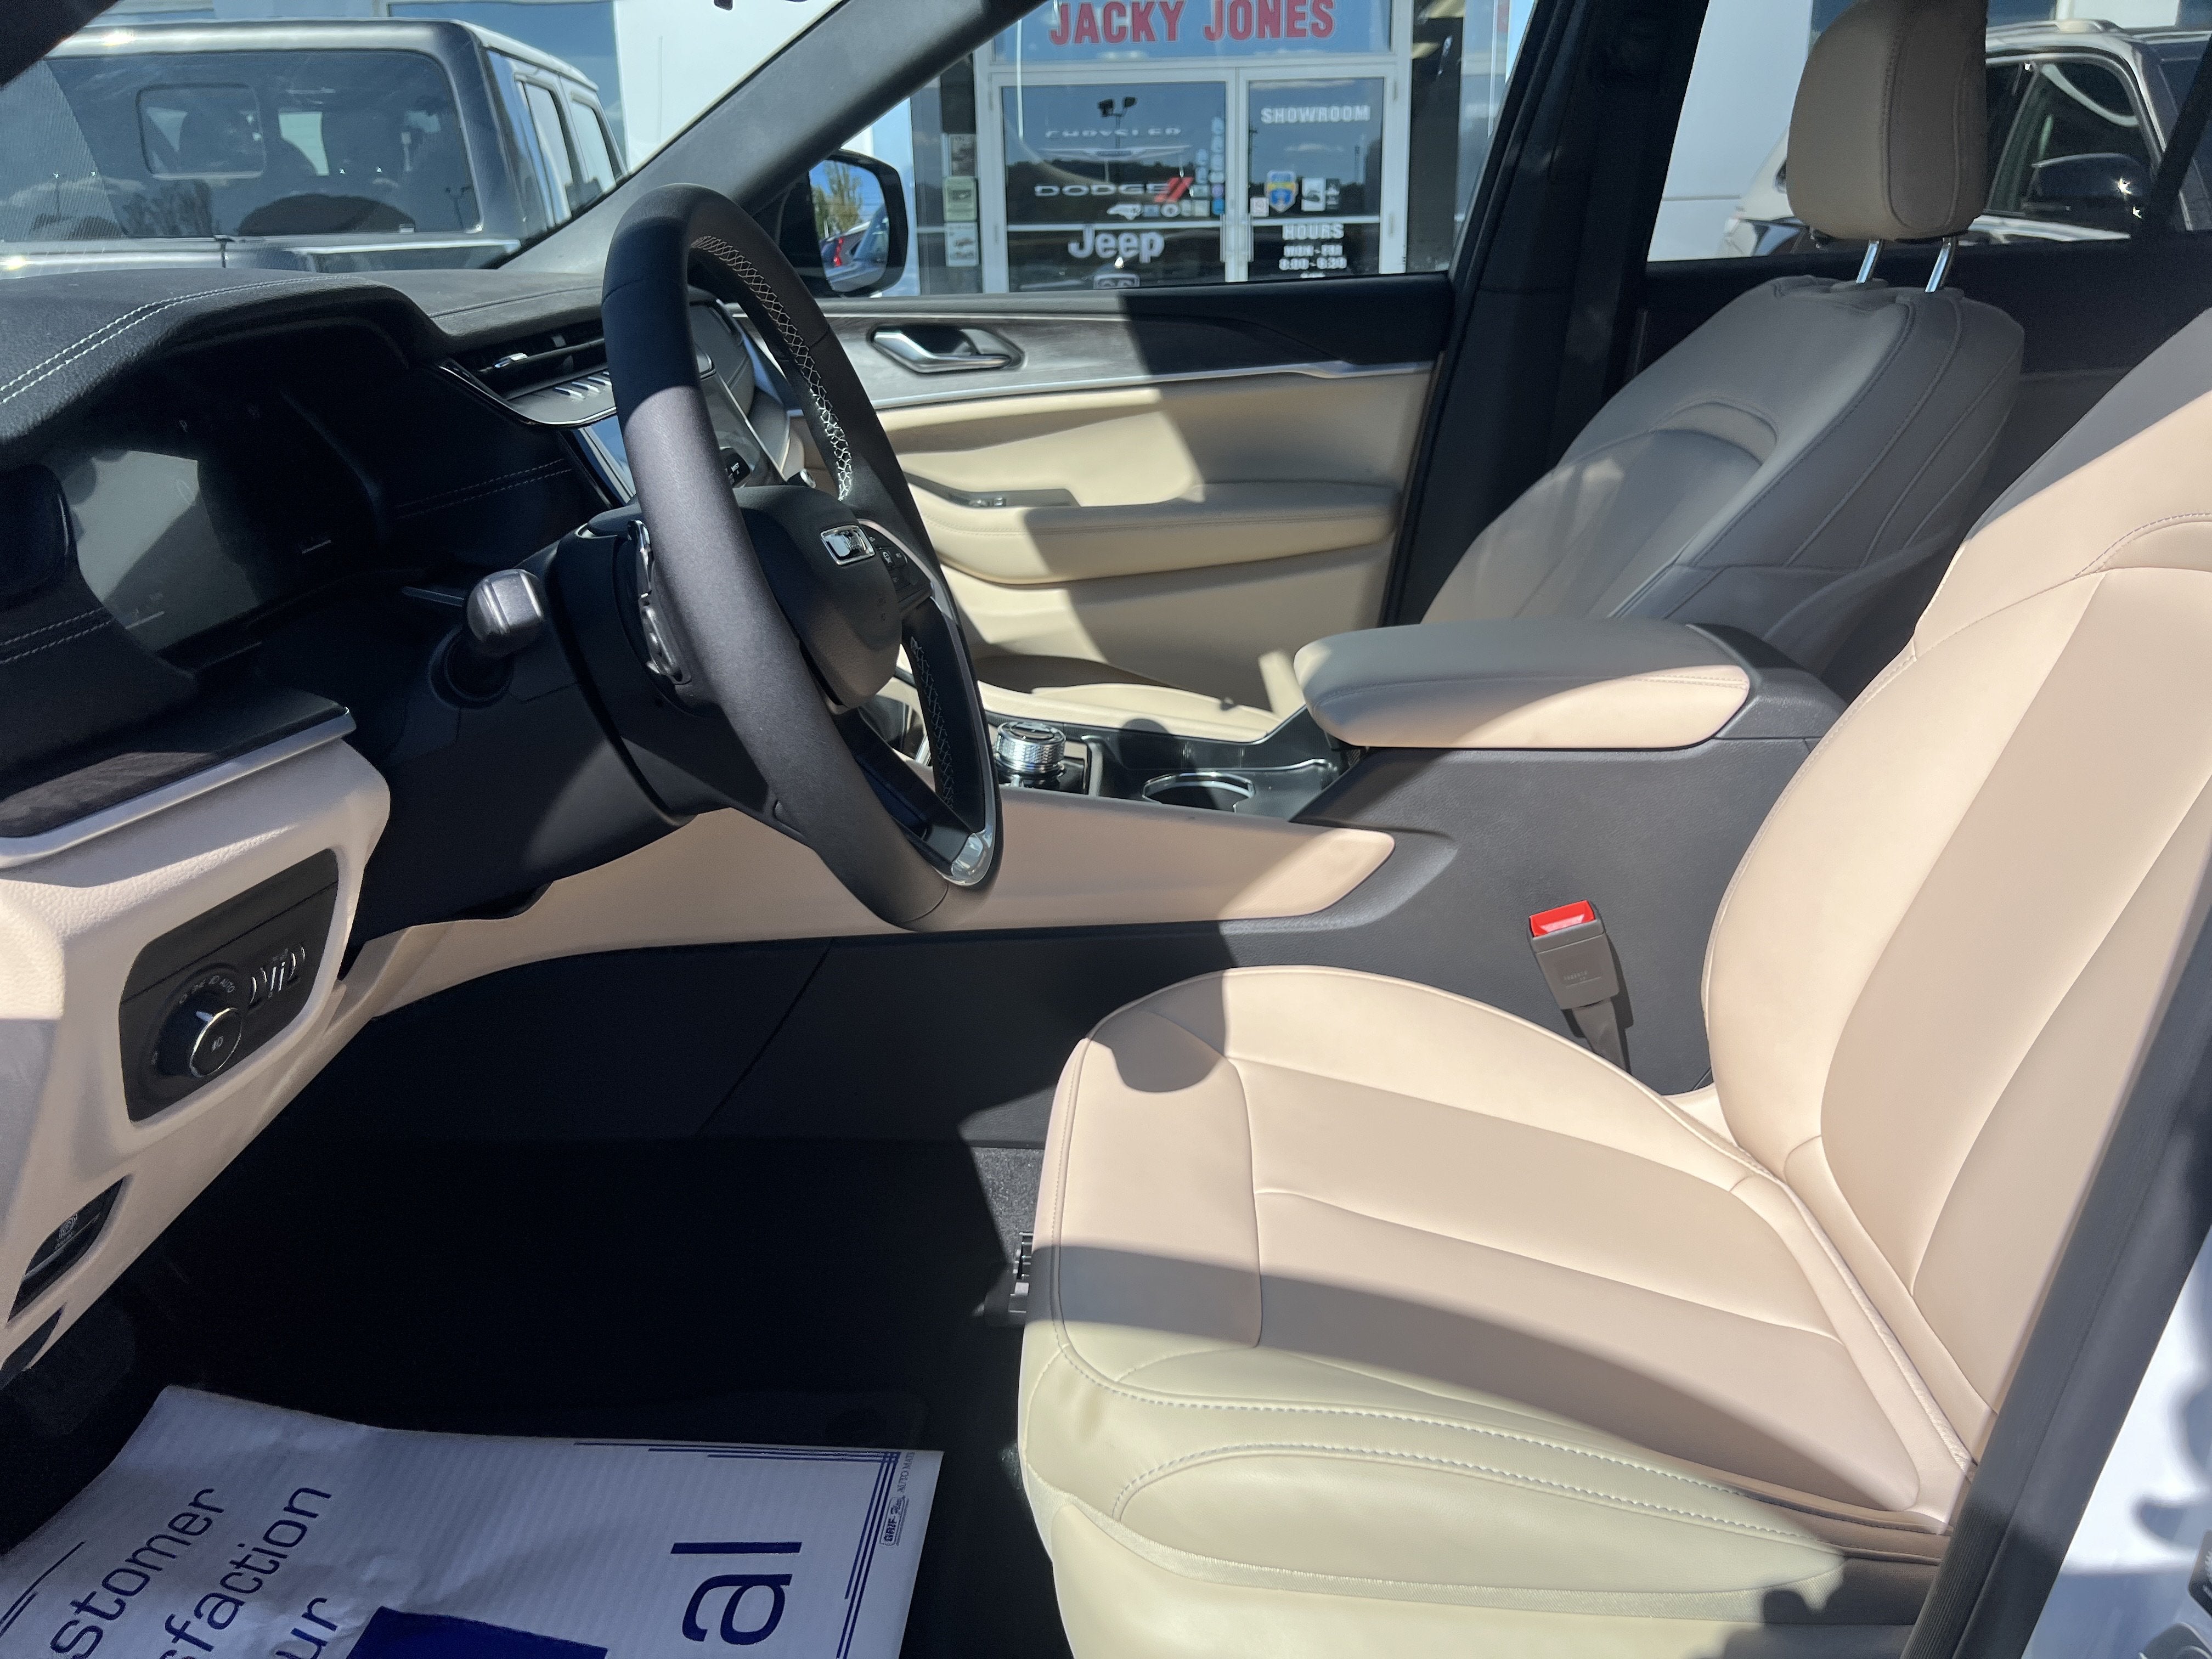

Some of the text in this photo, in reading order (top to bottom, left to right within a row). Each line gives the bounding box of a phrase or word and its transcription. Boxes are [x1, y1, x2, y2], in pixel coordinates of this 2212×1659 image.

[1049, 0, 1335, 45] JACKY JONES
[1261, 105, 1370, 124] SHOWROOM
[1034, 183, 1170, 196] DODGE
[1283, 223, 1344, 240] HOURS
[1068, 223, 1165, 264] Jeep
[220, 978, 235, 993] AUTO
[670, 1542, 802, 1645] al
